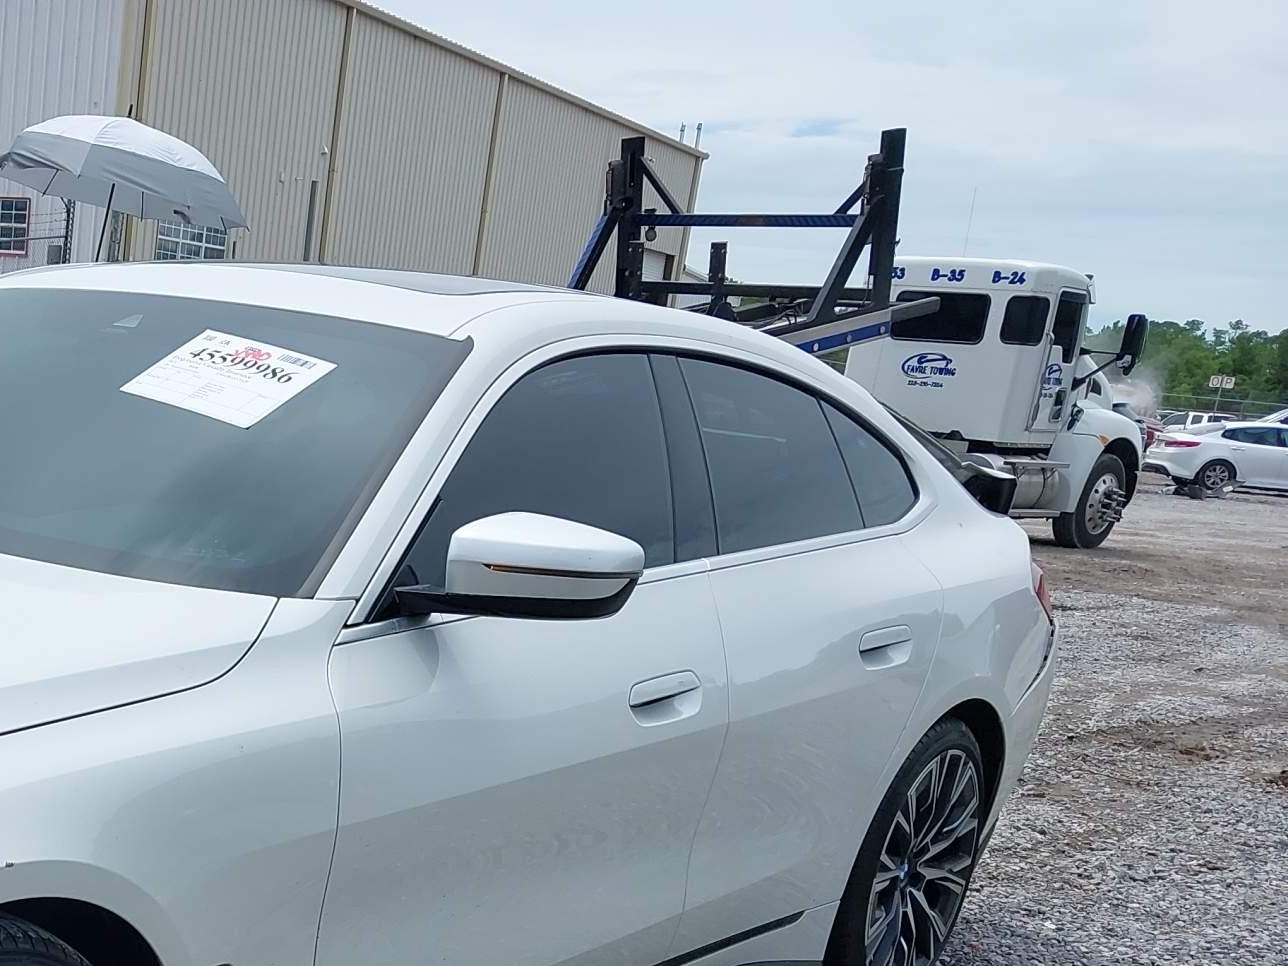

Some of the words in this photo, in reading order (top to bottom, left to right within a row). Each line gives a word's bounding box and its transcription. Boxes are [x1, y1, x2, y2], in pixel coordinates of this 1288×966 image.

[930, 268, 966, 282] B-35
[189, 347, 301, 384] 45599986
[907, 364, 929, 375] FAVRE
[930, 366, 957, 377] TOWING
